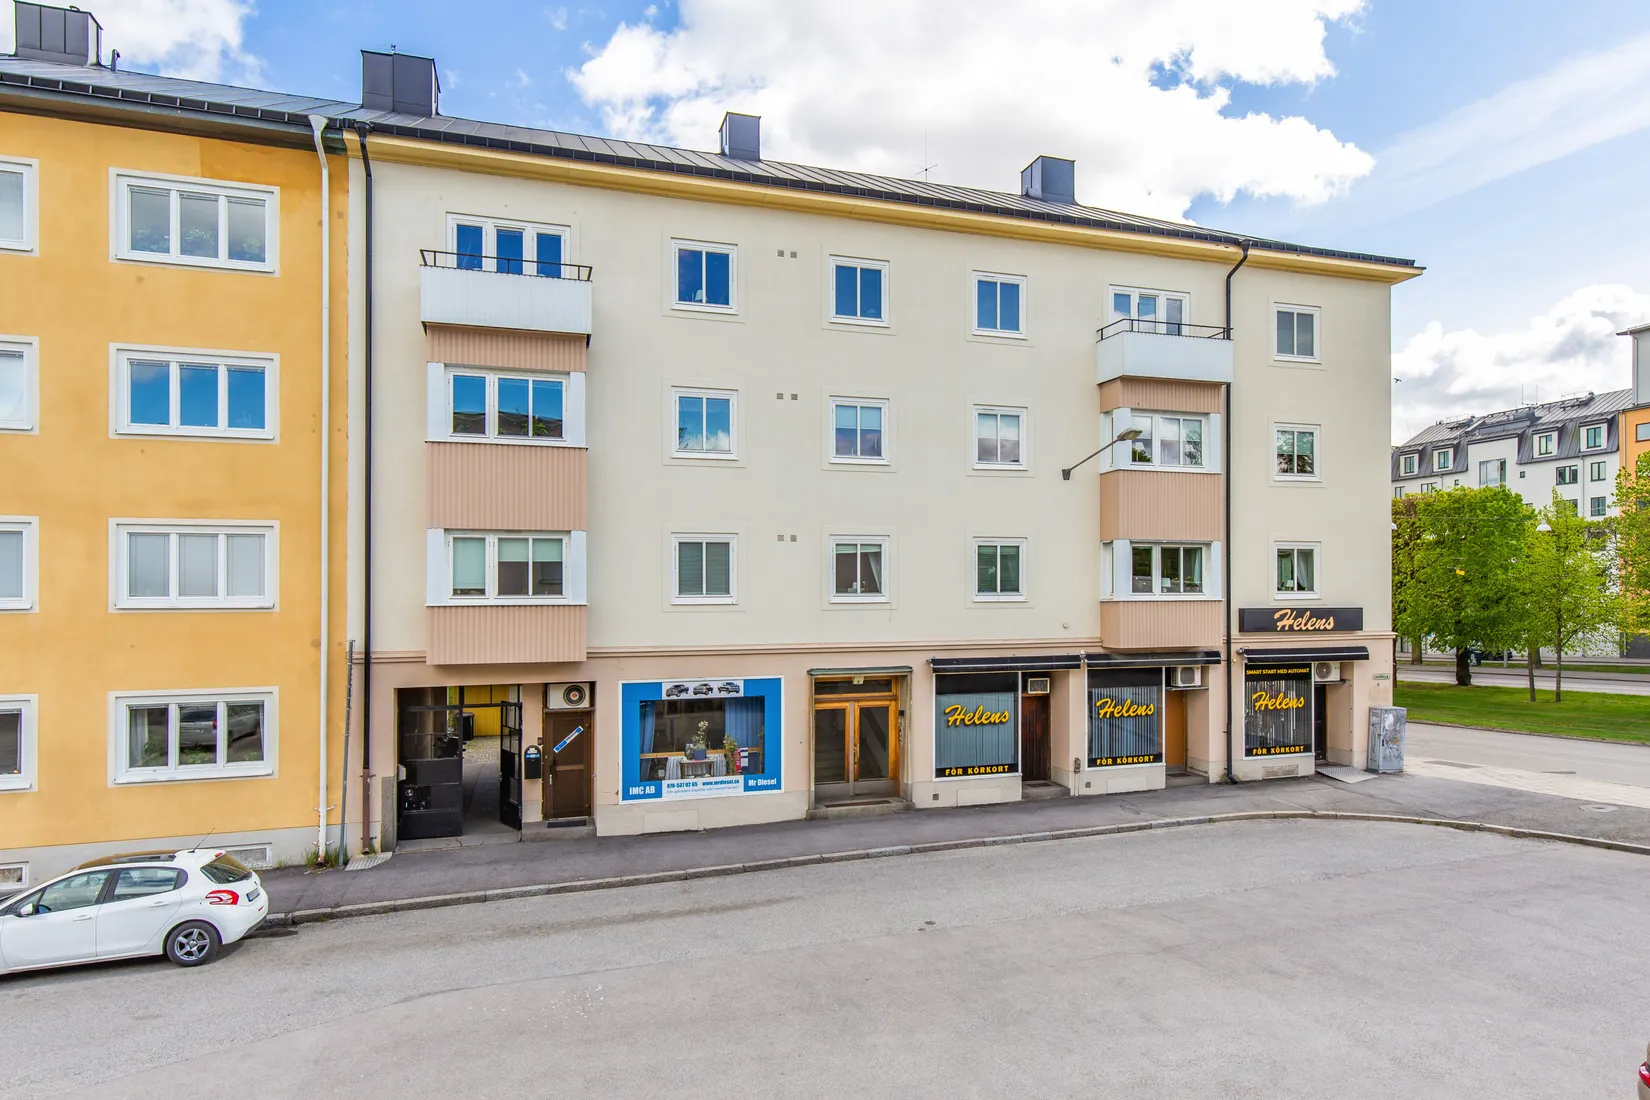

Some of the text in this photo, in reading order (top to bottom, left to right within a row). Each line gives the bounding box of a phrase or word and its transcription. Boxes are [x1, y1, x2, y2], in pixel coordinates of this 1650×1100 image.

[1274, 609, 1334, 631] Helens
[1252, 691, 1305, 711] Helens
[1095, 698, 1155, 719] Helens
[944, 704, 1009, 726] Helens
[1252, 745, 1304, 755] FÖR KÖRKORT
[1096, 755, 1154, 765] FÖR KÖRKORT
[945, 765, 1009, 776] FÖR KÖRKORT
[748, 777, 777, 787] Mr Diesel
[629, 785, 655, 795] IMC AB
